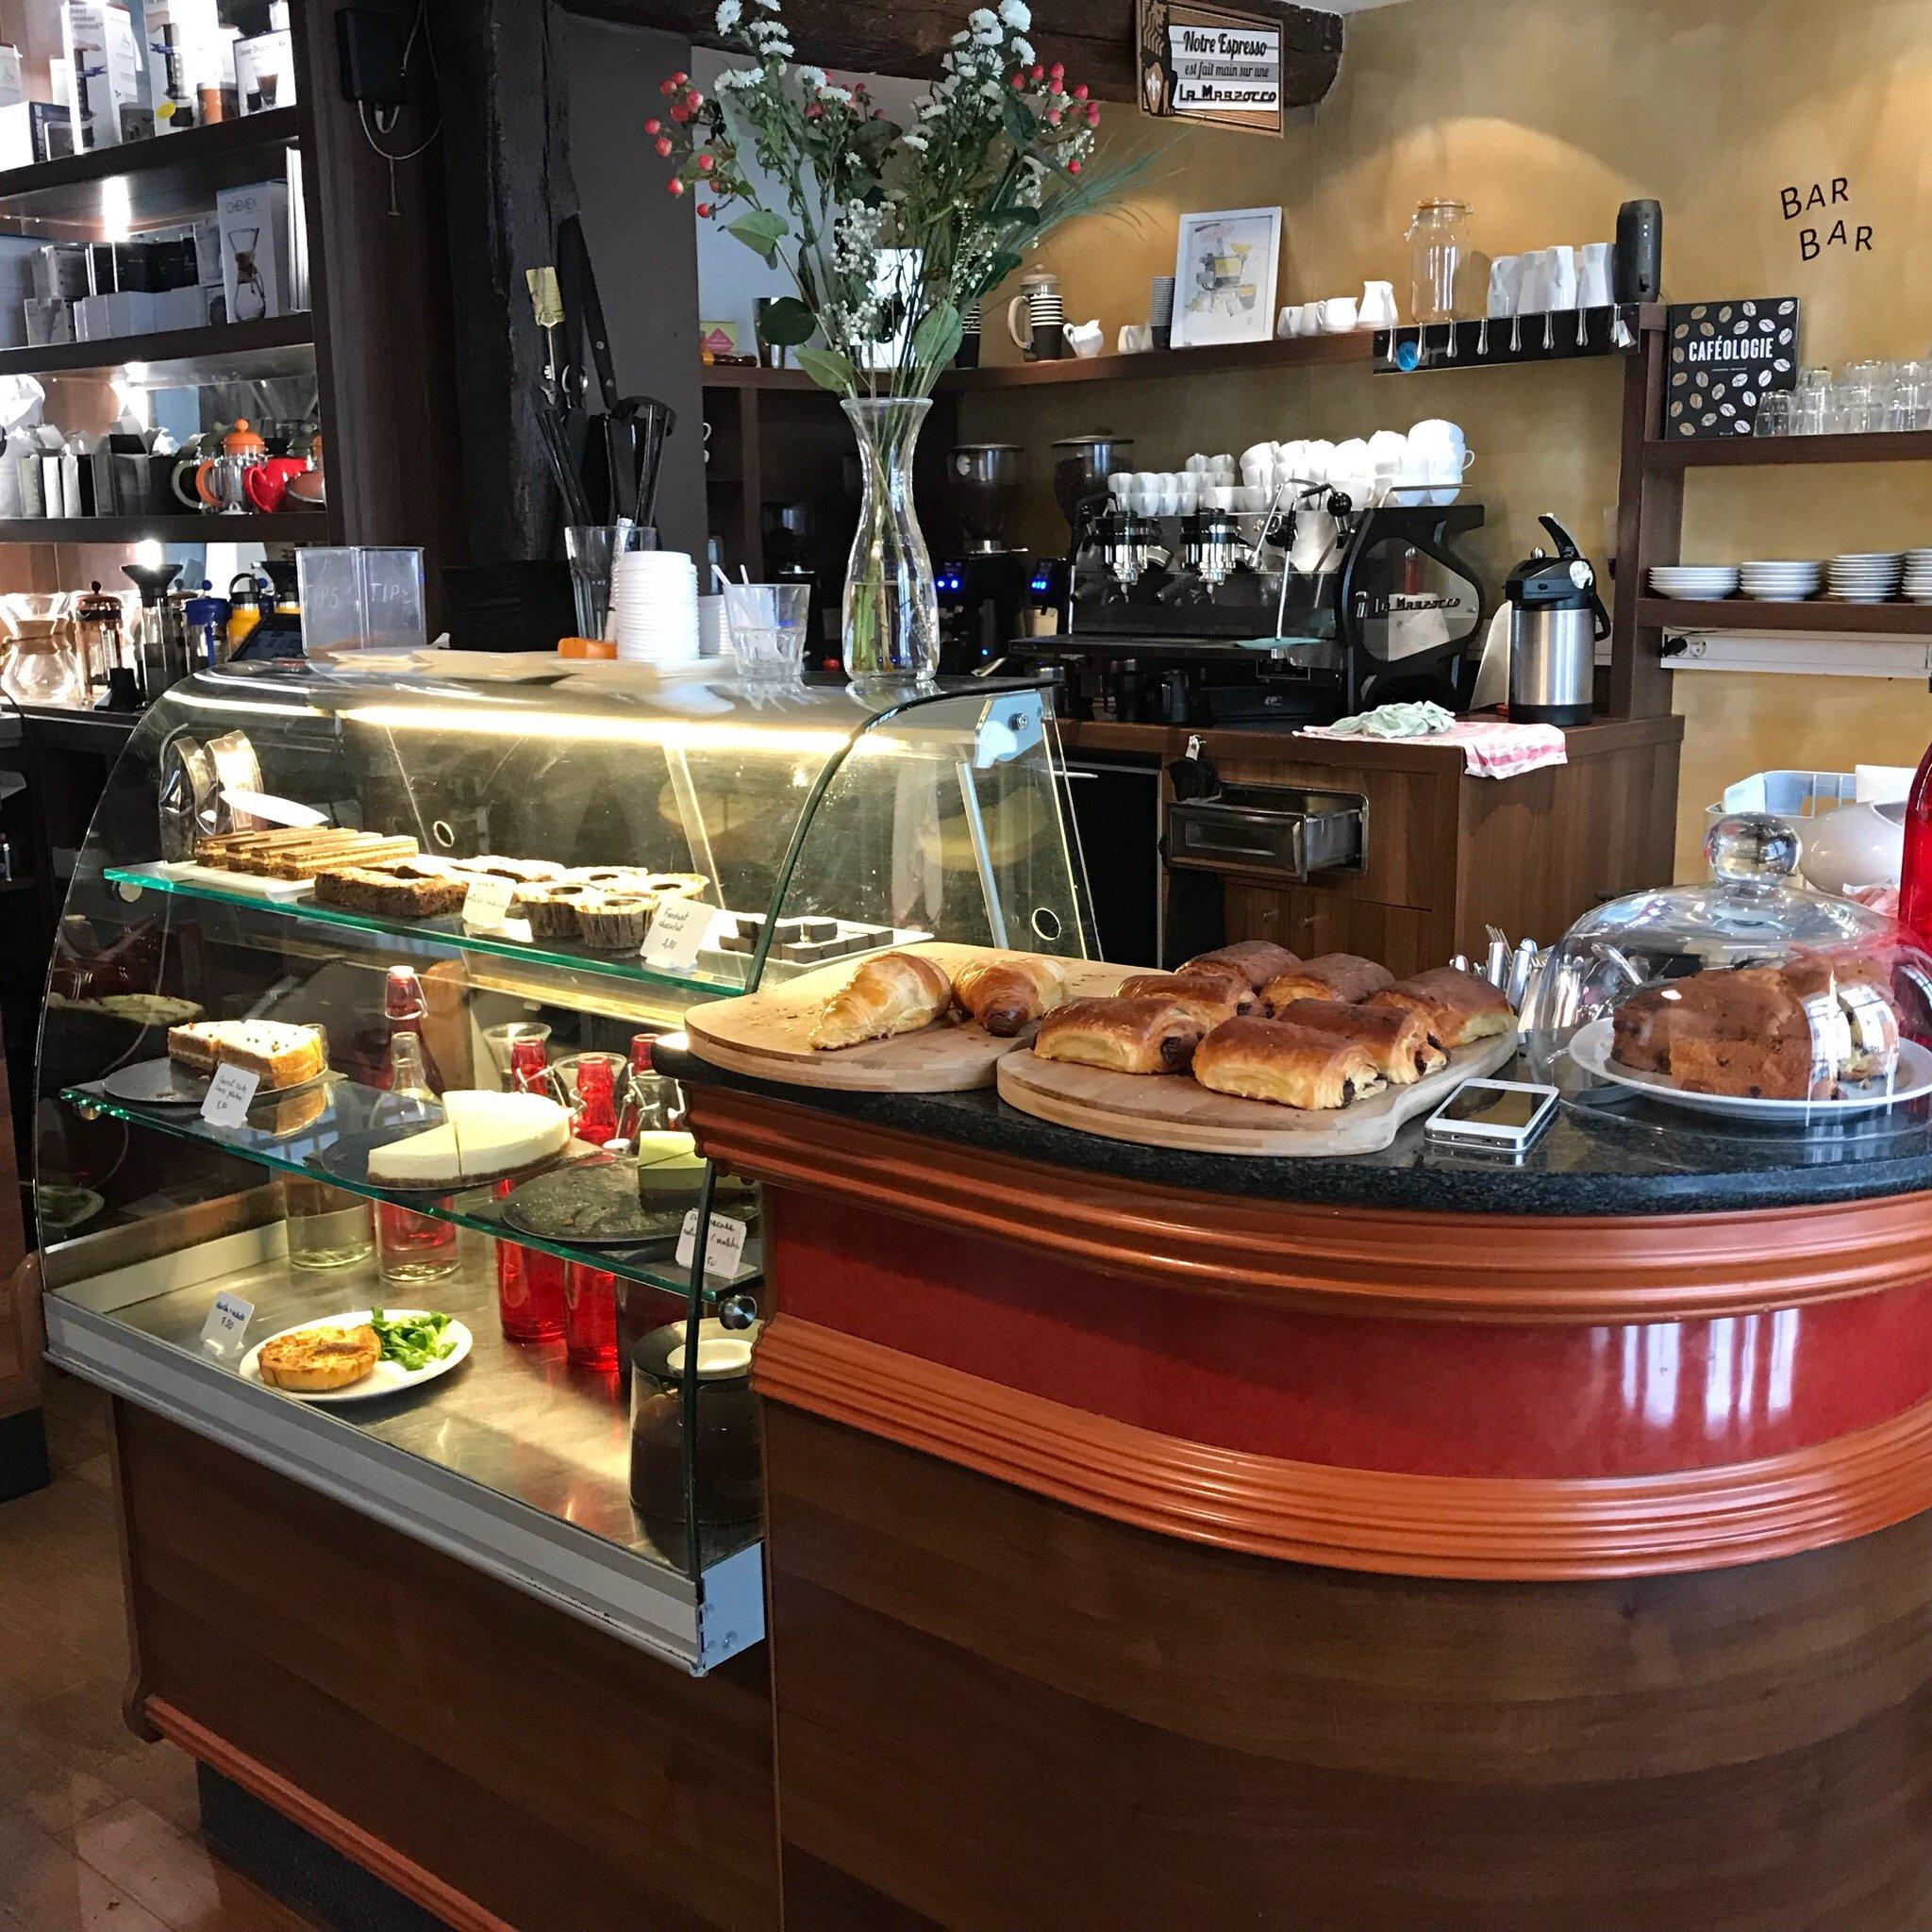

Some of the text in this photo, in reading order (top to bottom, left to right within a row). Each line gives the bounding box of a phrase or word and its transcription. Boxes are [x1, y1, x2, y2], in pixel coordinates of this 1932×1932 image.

[1183, 30, 1268, 61] Notre Espresso
[1185, 61, 1270, 80] est fait main sur une
[1780, 177, 1849, 220] BAR
[1799, 219, 1873, 261] BAR
[1688, 335, 1774, 362] CAFÉOLOGIE
[370, 582, 413, 604] TIPS
